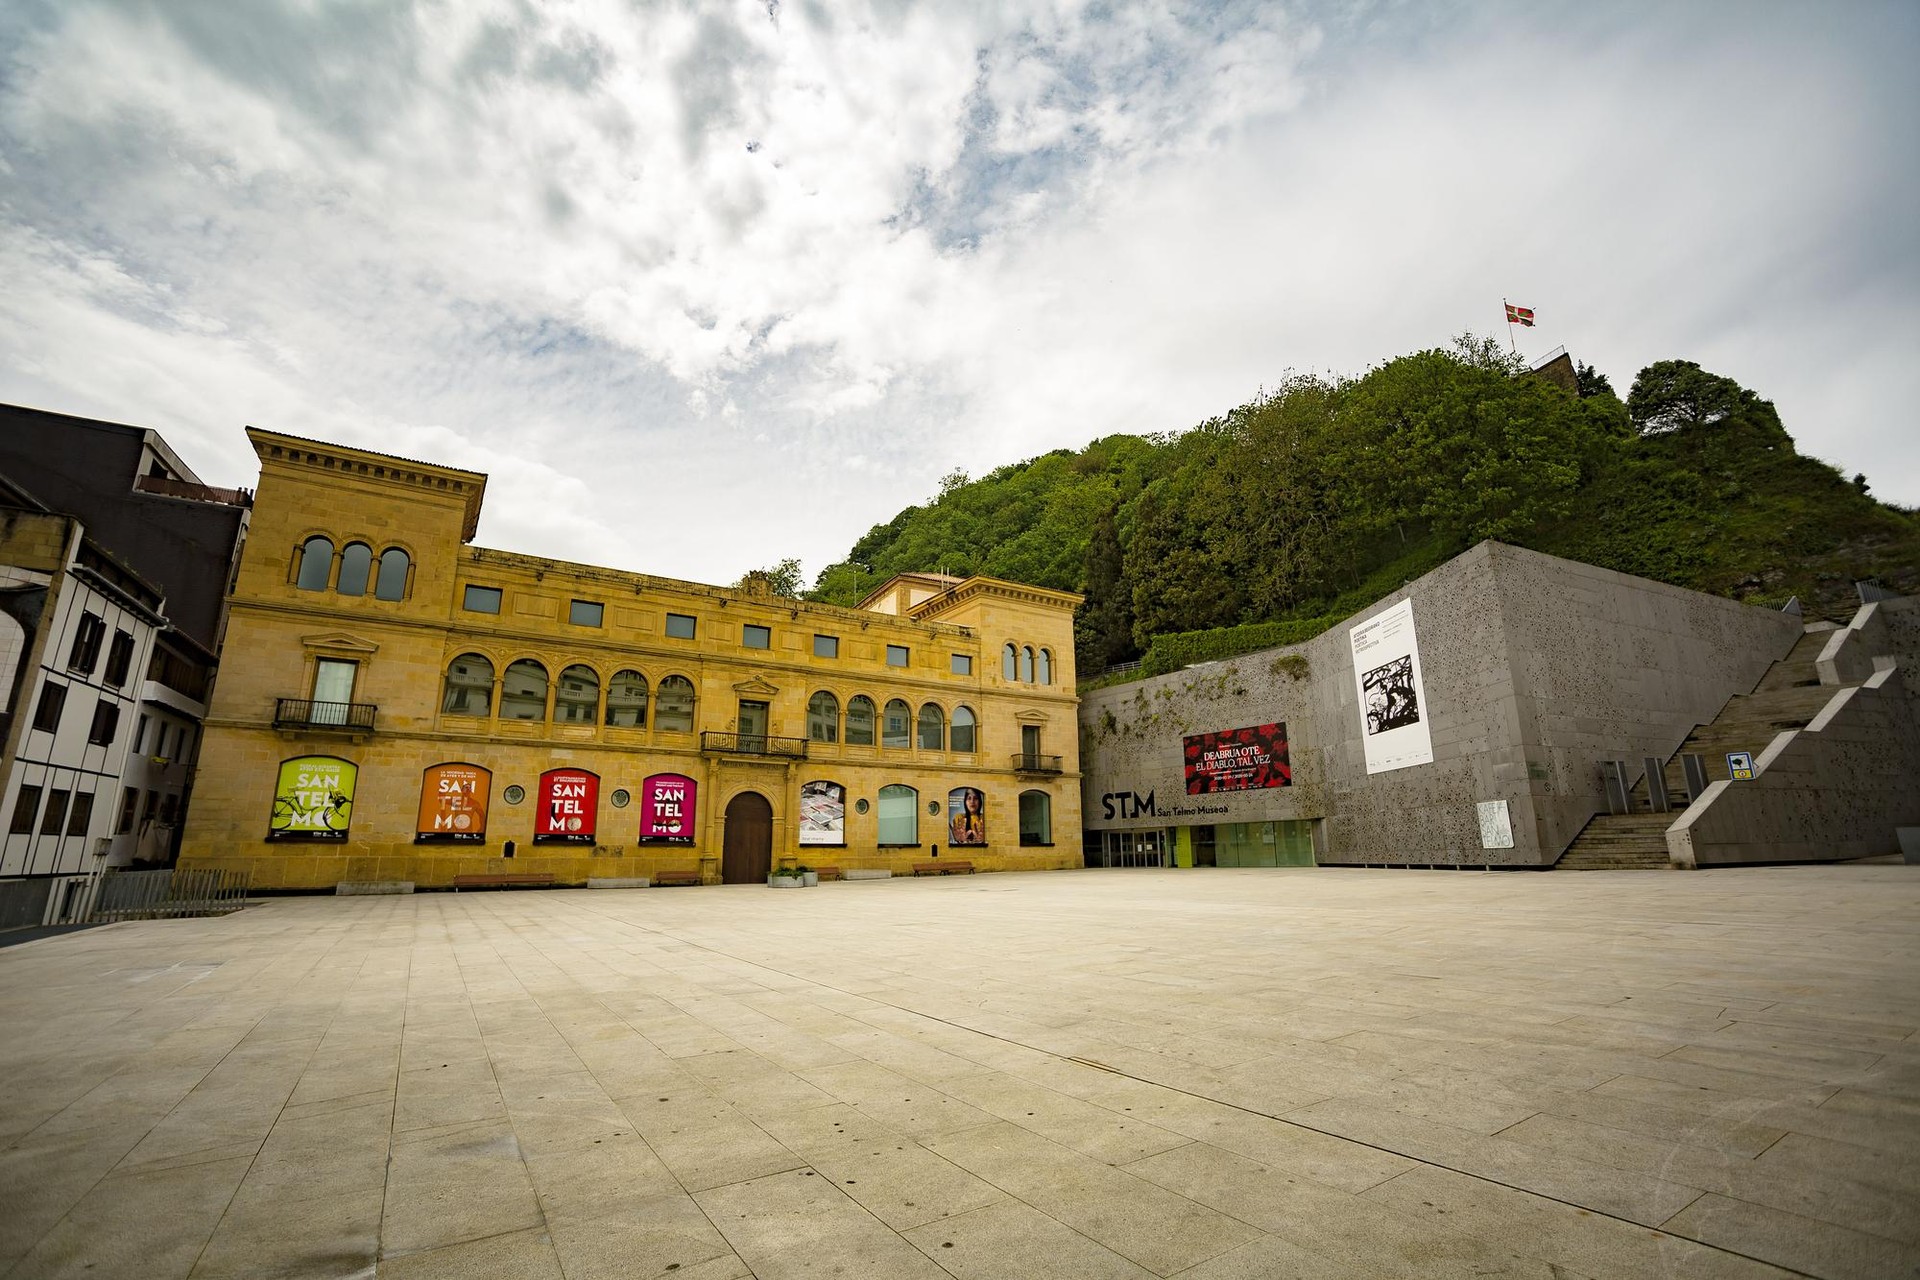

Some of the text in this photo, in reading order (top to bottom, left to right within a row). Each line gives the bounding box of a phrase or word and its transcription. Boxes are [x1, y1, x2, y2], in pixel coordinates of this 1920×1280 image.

[1204, 746, 1260, 761] DEABRUA OTE
[1196, 763, 1206, 771] EL
[1206, 759, 1237, 770] DIABLO,
[1237, 757, 1253, 766] TAL
[1254, 754, 1271, 764] VEZ
[297, 773, 339, 788] SAN
[439, 780, 476, 793] SAN
[552, 784, 586, 797] SAN
[654, 788, 684, 801] SAN
[295, 791, 334, 807] TEL
[438, 796, 472, 810] TEL
[1101, 789, 1229, 820] STM San Telmo Museoa
[551, 800, 583, 814] TEL
[653, 803, 683, 817] TEL
[290, 810, 332, 827] MO
[434, 814, 471, 829] MO
[549, 817, 582, 831] MO
[652, 820, 682, 833] MO
